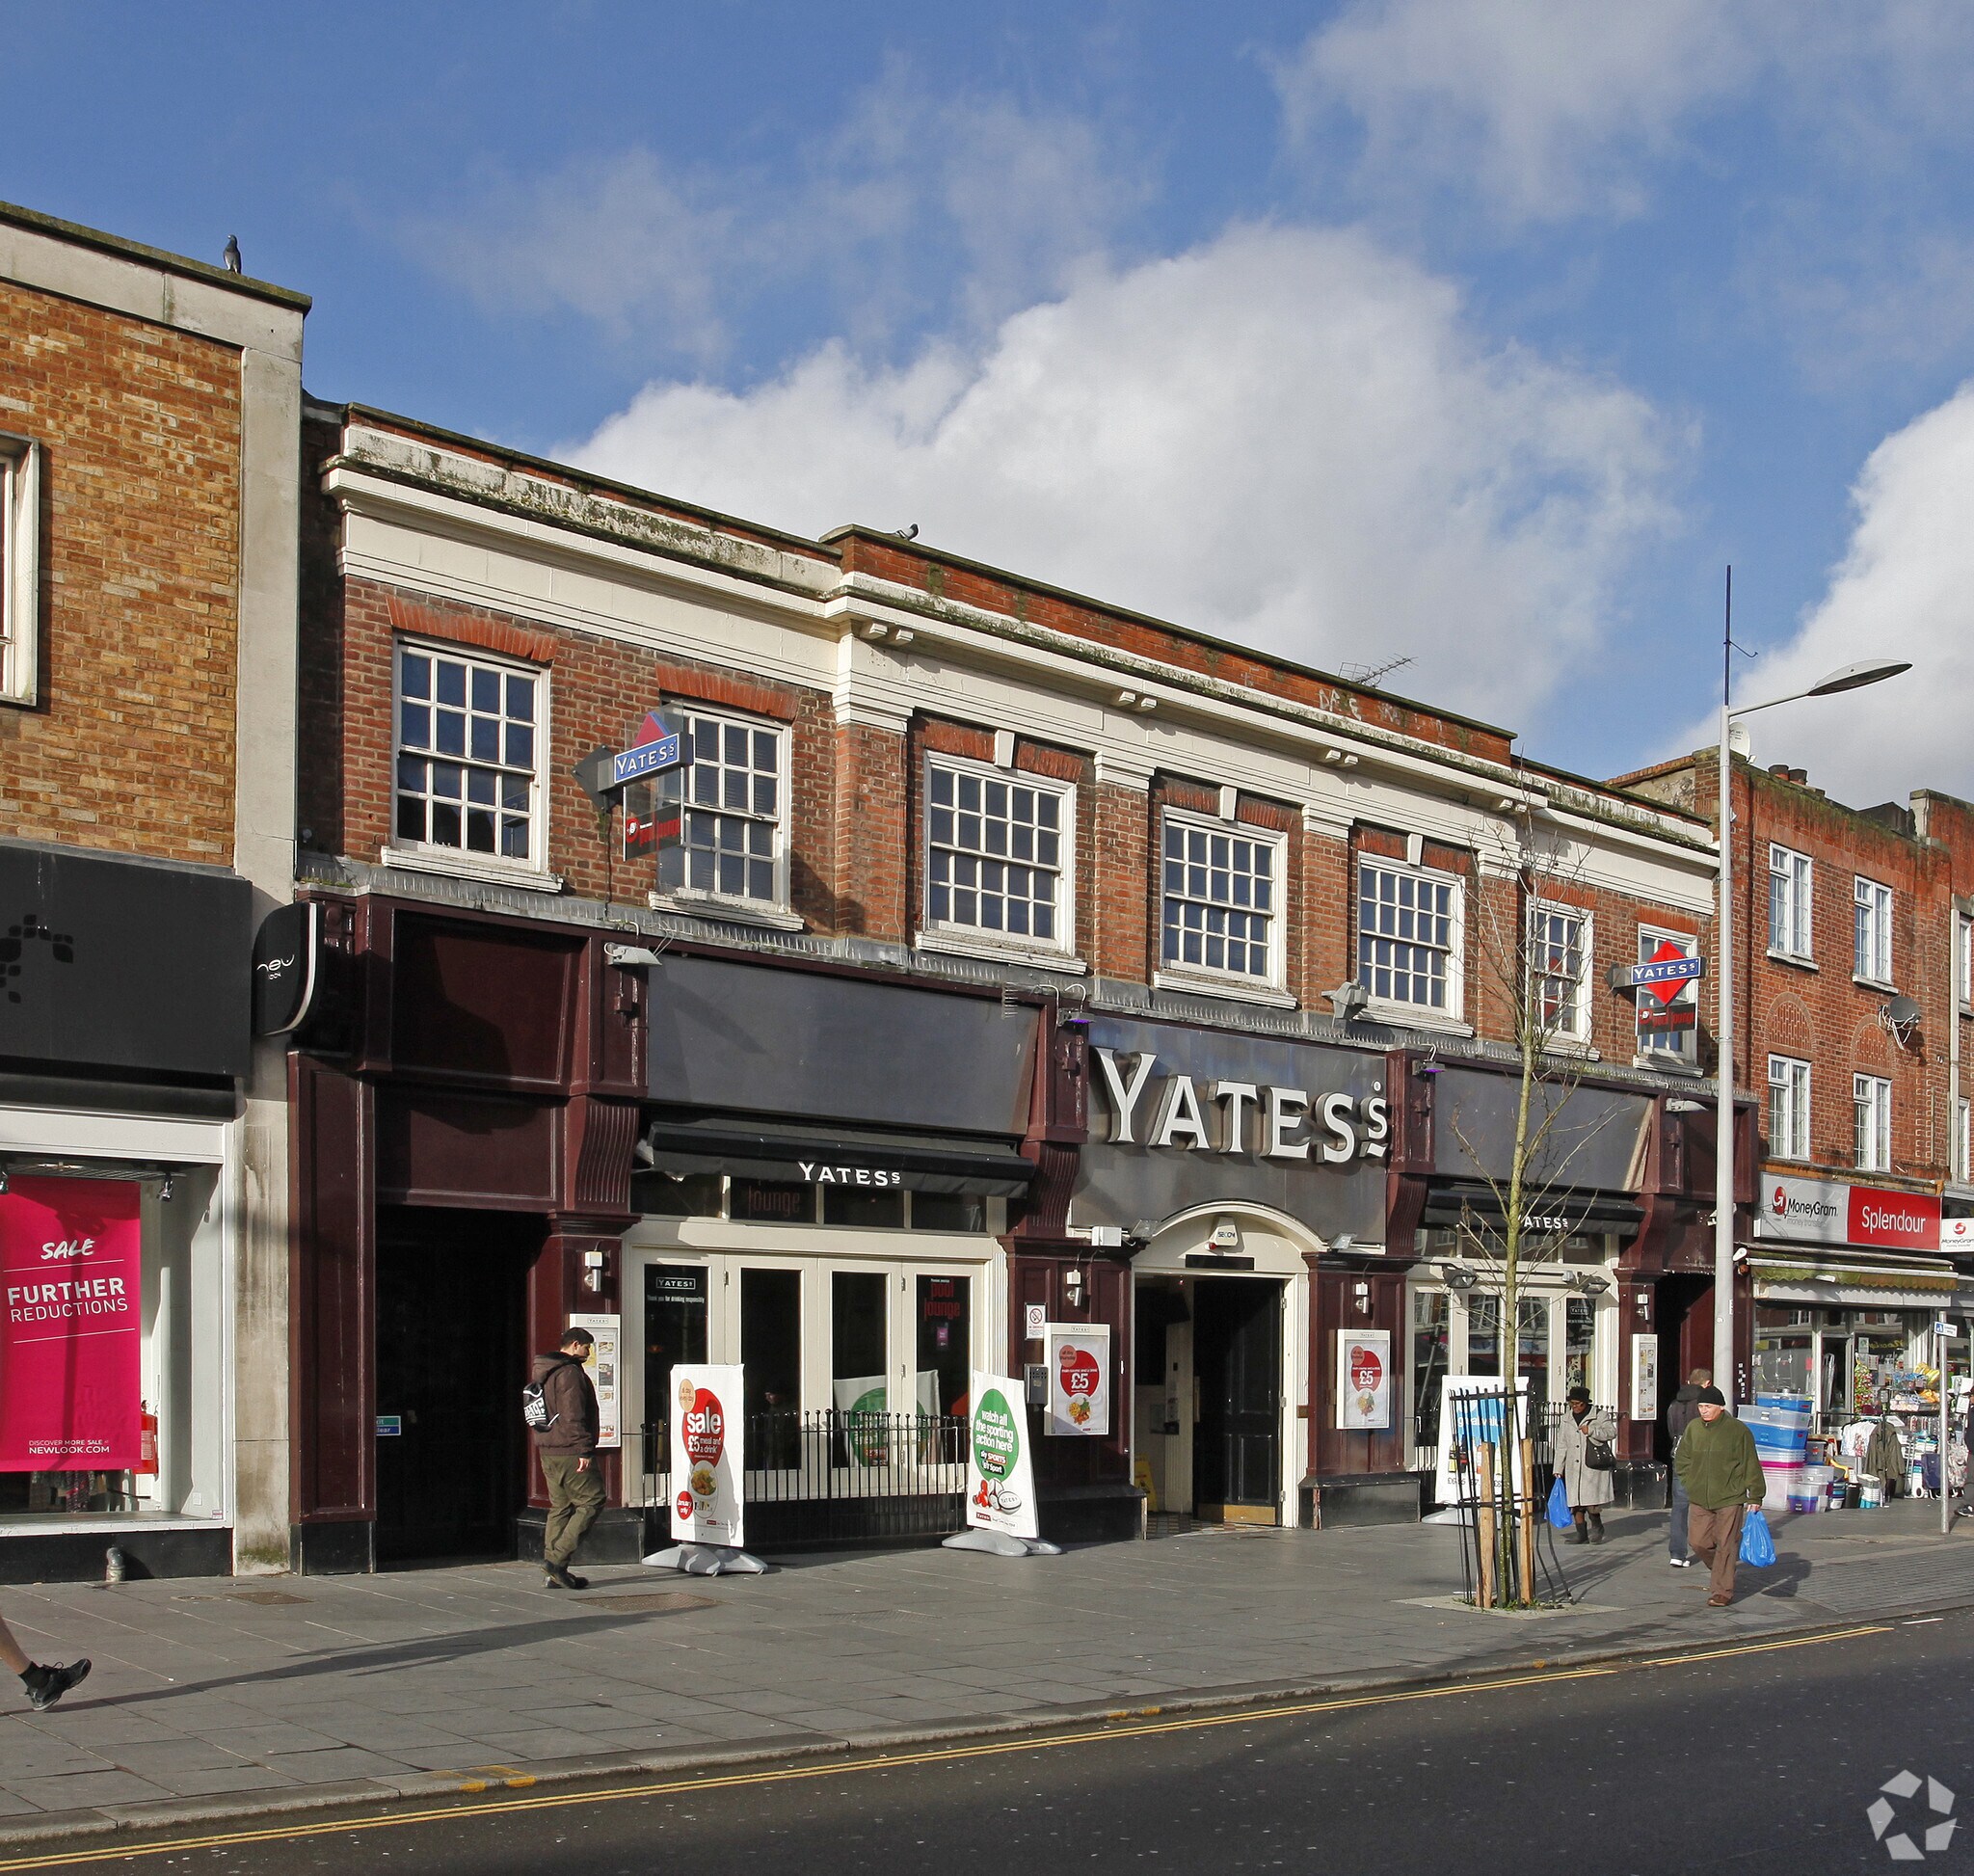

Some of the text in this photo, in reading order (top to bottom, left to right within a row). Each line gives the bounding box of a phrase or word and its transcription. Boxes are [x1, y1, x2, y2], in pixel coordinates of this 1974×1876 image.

[1787, 1198, 1838, 1218] MoneyGram
[1861, 1205, 1926, 1234] Splendour
[40, 1239, 94, 1260] SALE
[8, 1277, 125, 1305] FURTHER
[11, 1298, 128, 1323] REDUCTIONS
[1070, 1372, 1089, 1389] £5
[1359, 1370, 1374, 1385] £5
[686, 1407, 722, 1434] sale
[981, 1410, 1008, 1427] watch all
[975, 1419, 1014, 1443] the sporting
[687, 1434, 700, 1453] £5
[975, 1434, 1013, 1453] action here
